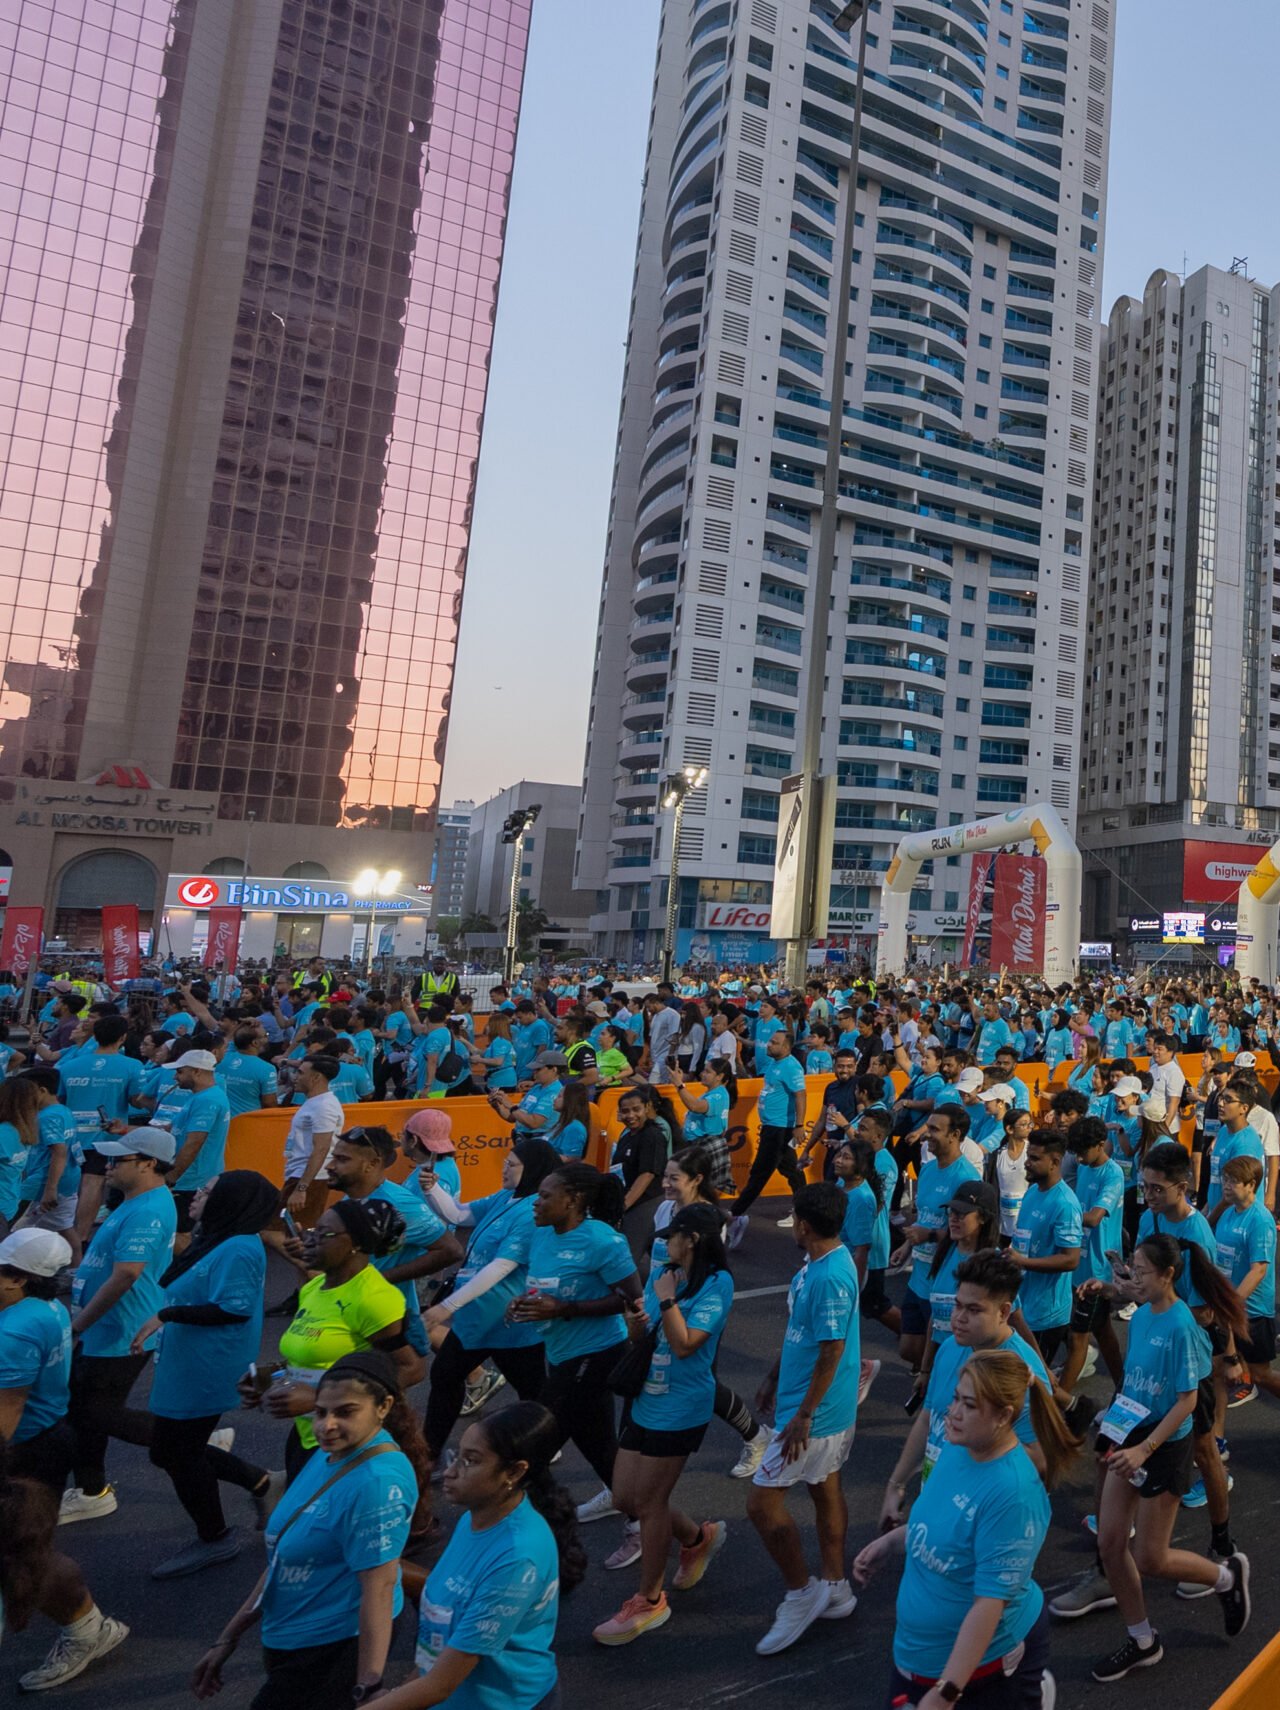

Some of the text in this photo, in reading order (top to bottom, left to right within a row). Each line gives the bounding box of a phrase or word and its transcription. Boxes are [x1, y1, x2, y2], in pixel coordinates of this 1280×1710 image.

[16, 811, 44, 827] AL
[52, 813, 129, 831] MOOSA
[133, 818, 201, 835] TOWER
[931, 836, 951, 851] RUN
[840, 878, 878, 886] TOWER
[227, 882, 348, 907] BinSina
[355, 900, 412, 910] PHARMACY
[709, 906, 771, 928] Lifco
[1011, 867, 1036, 964] Mai Dubai
